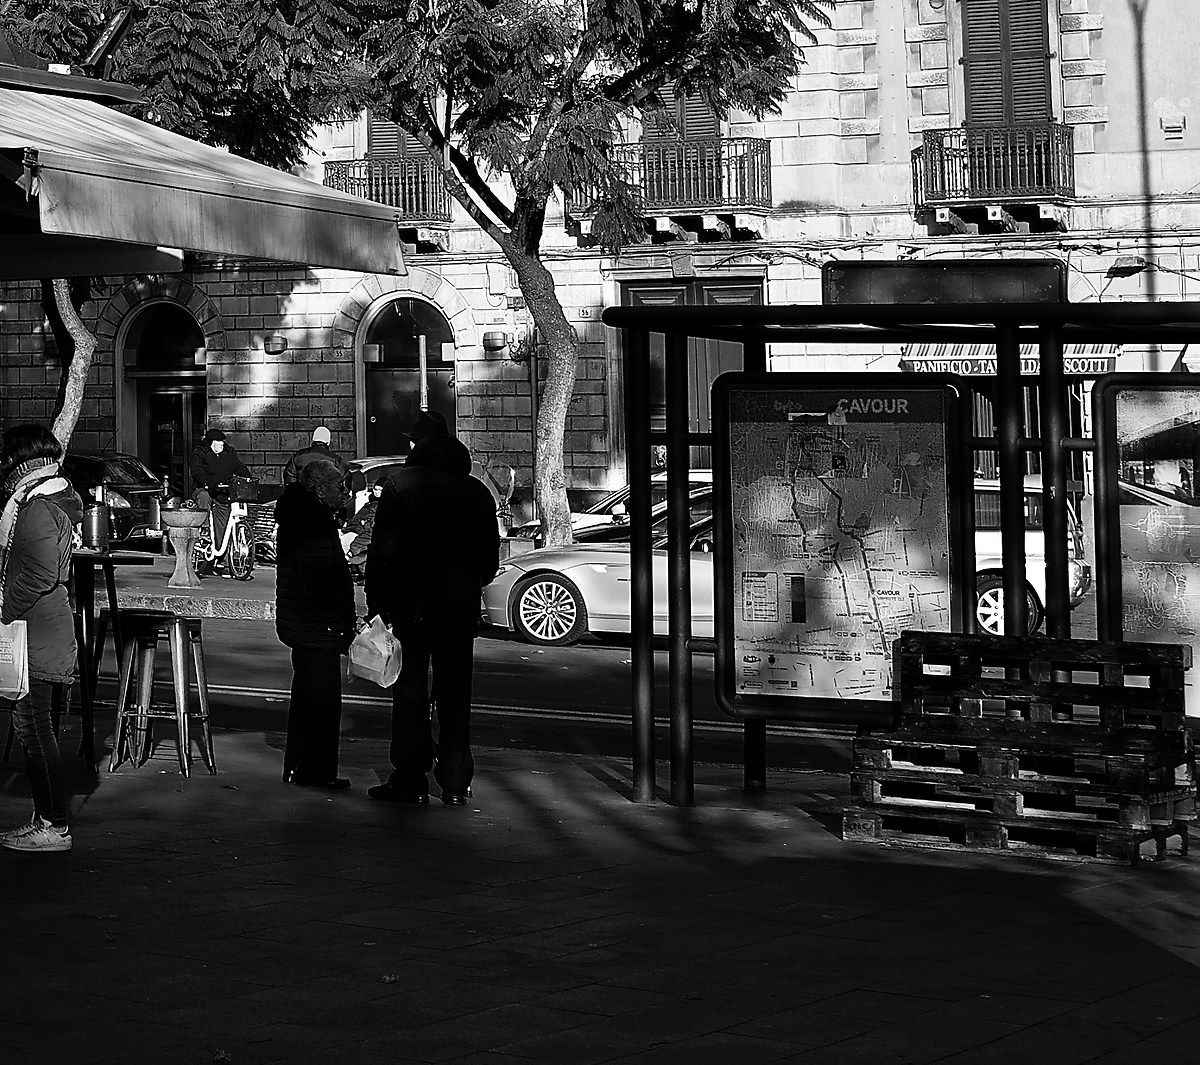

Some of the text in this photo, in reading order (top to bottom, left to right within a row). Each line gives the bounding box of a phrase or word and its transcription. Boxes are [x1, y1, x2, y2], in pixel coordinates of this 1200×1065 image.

[912, 359, 972, 375] PANIFICIO
[1063, 358, 1109, 373] SCOTTI
[836, 398, 909, 414] CAVOUR
